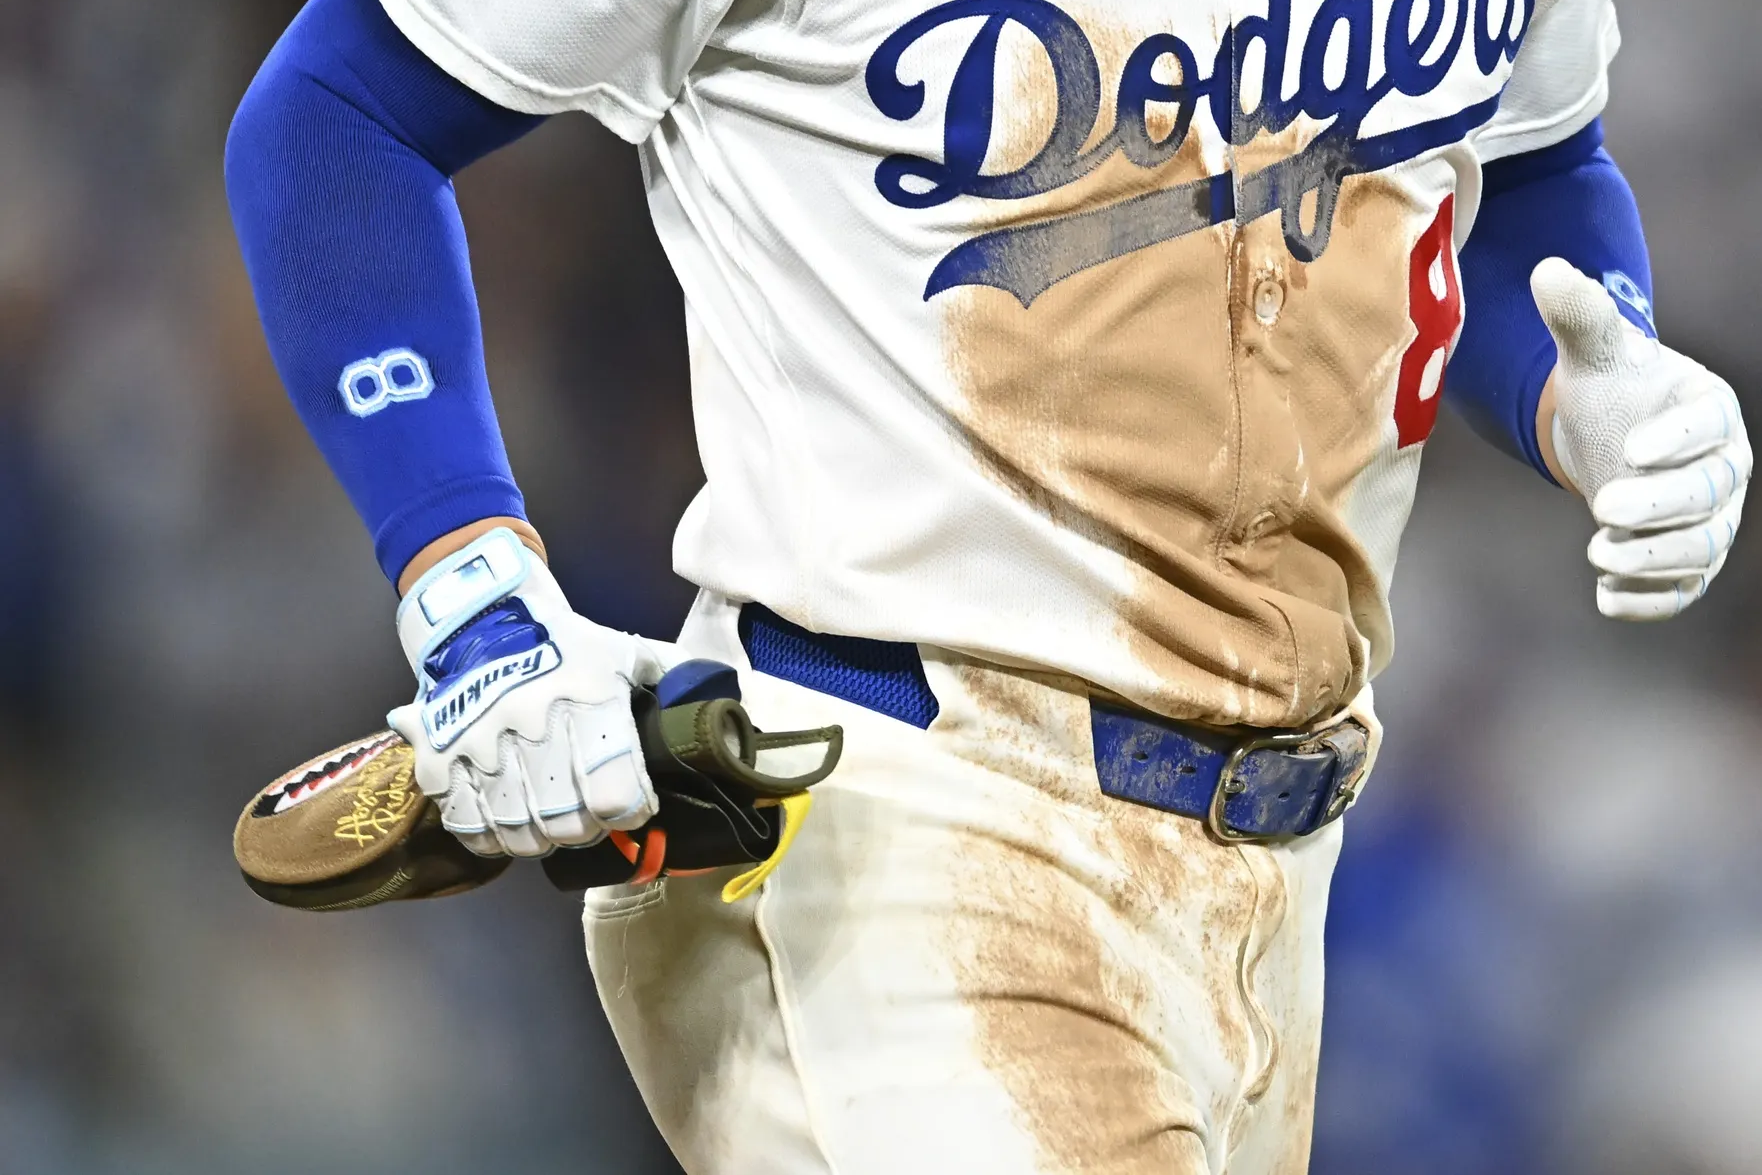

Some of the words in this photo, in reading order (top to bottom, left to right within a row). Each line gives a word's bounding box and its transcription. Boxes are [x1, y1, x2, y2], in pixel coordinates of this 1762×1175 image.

[1394, 192, 1462, 451] 8
[338, 347, 436, 418] 8
[434, 650, 543, 731] Franklin
